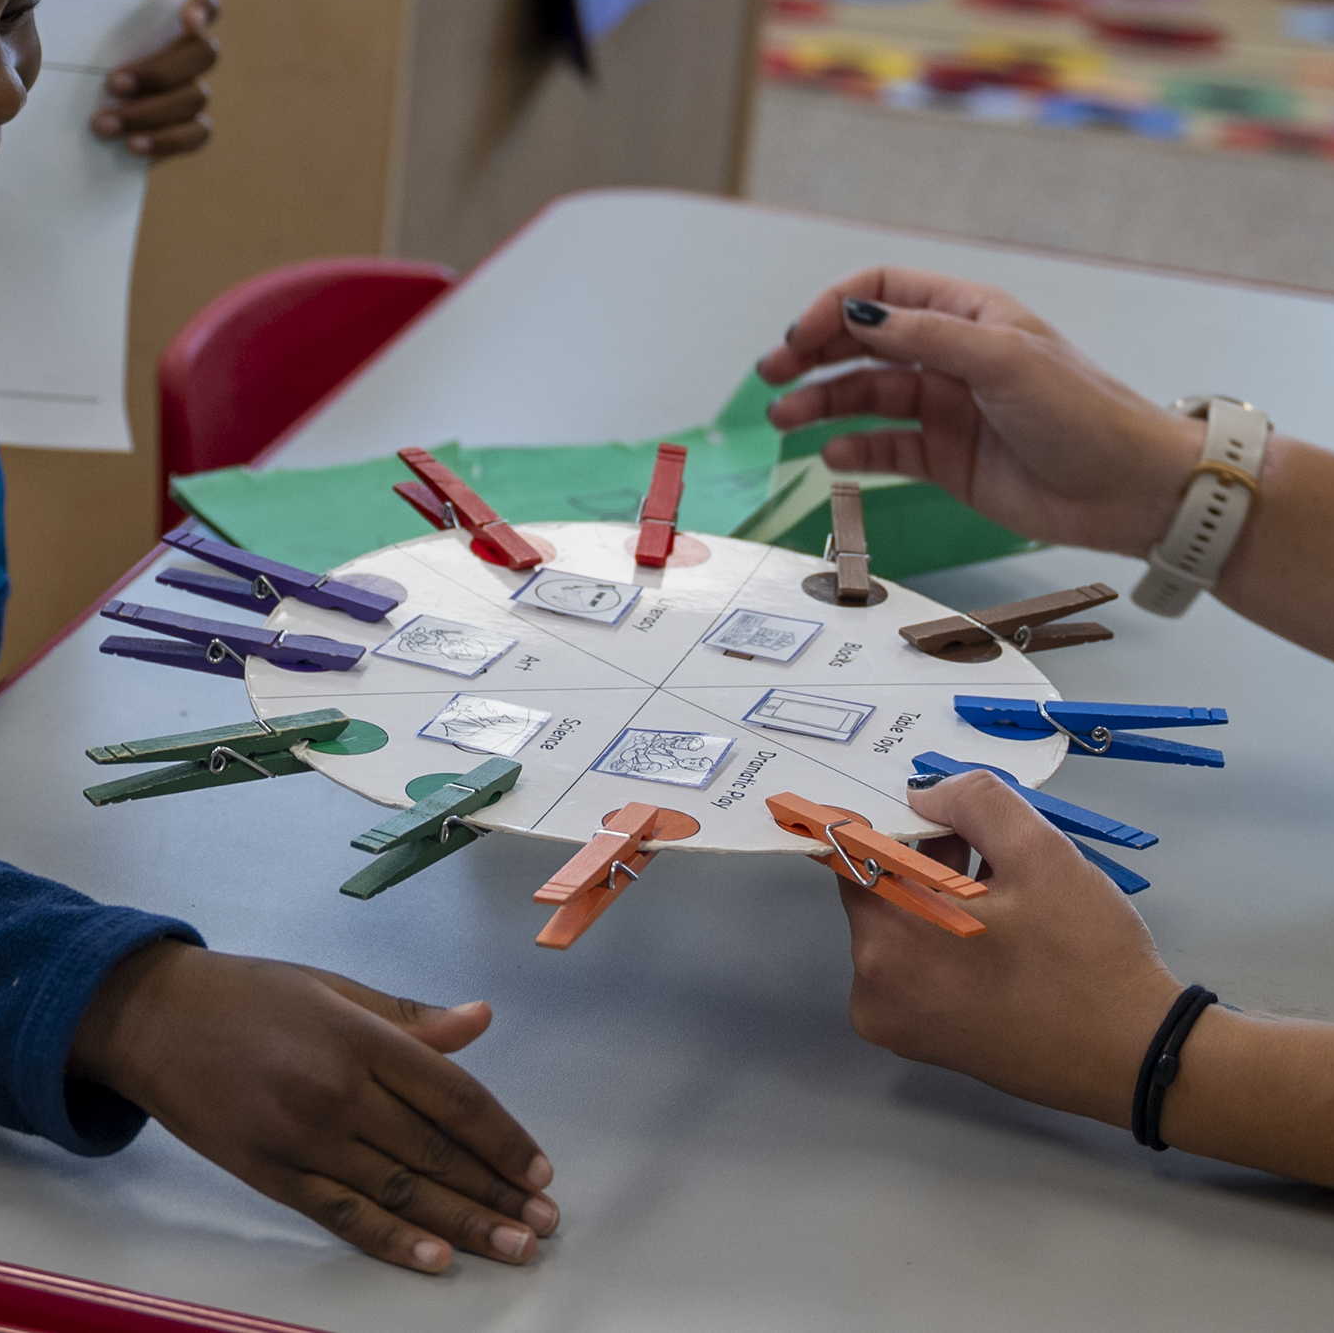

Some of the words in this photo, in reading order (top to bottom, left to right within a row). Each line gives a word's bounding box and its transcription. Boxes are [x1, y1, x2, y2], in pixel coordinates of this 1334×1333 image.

[631, 598, 676, 633] Literacy
[514, 654, 540, 671] Art
[828, 642, 862, 667] Blocks
[540, 718, 581, 750] Science
[889, 712, 921, 733] Table
[872, 736, 903, 753] Toys
[731, 750, 777, 789] Dramatic
[710, 790, 745, 809] Play
